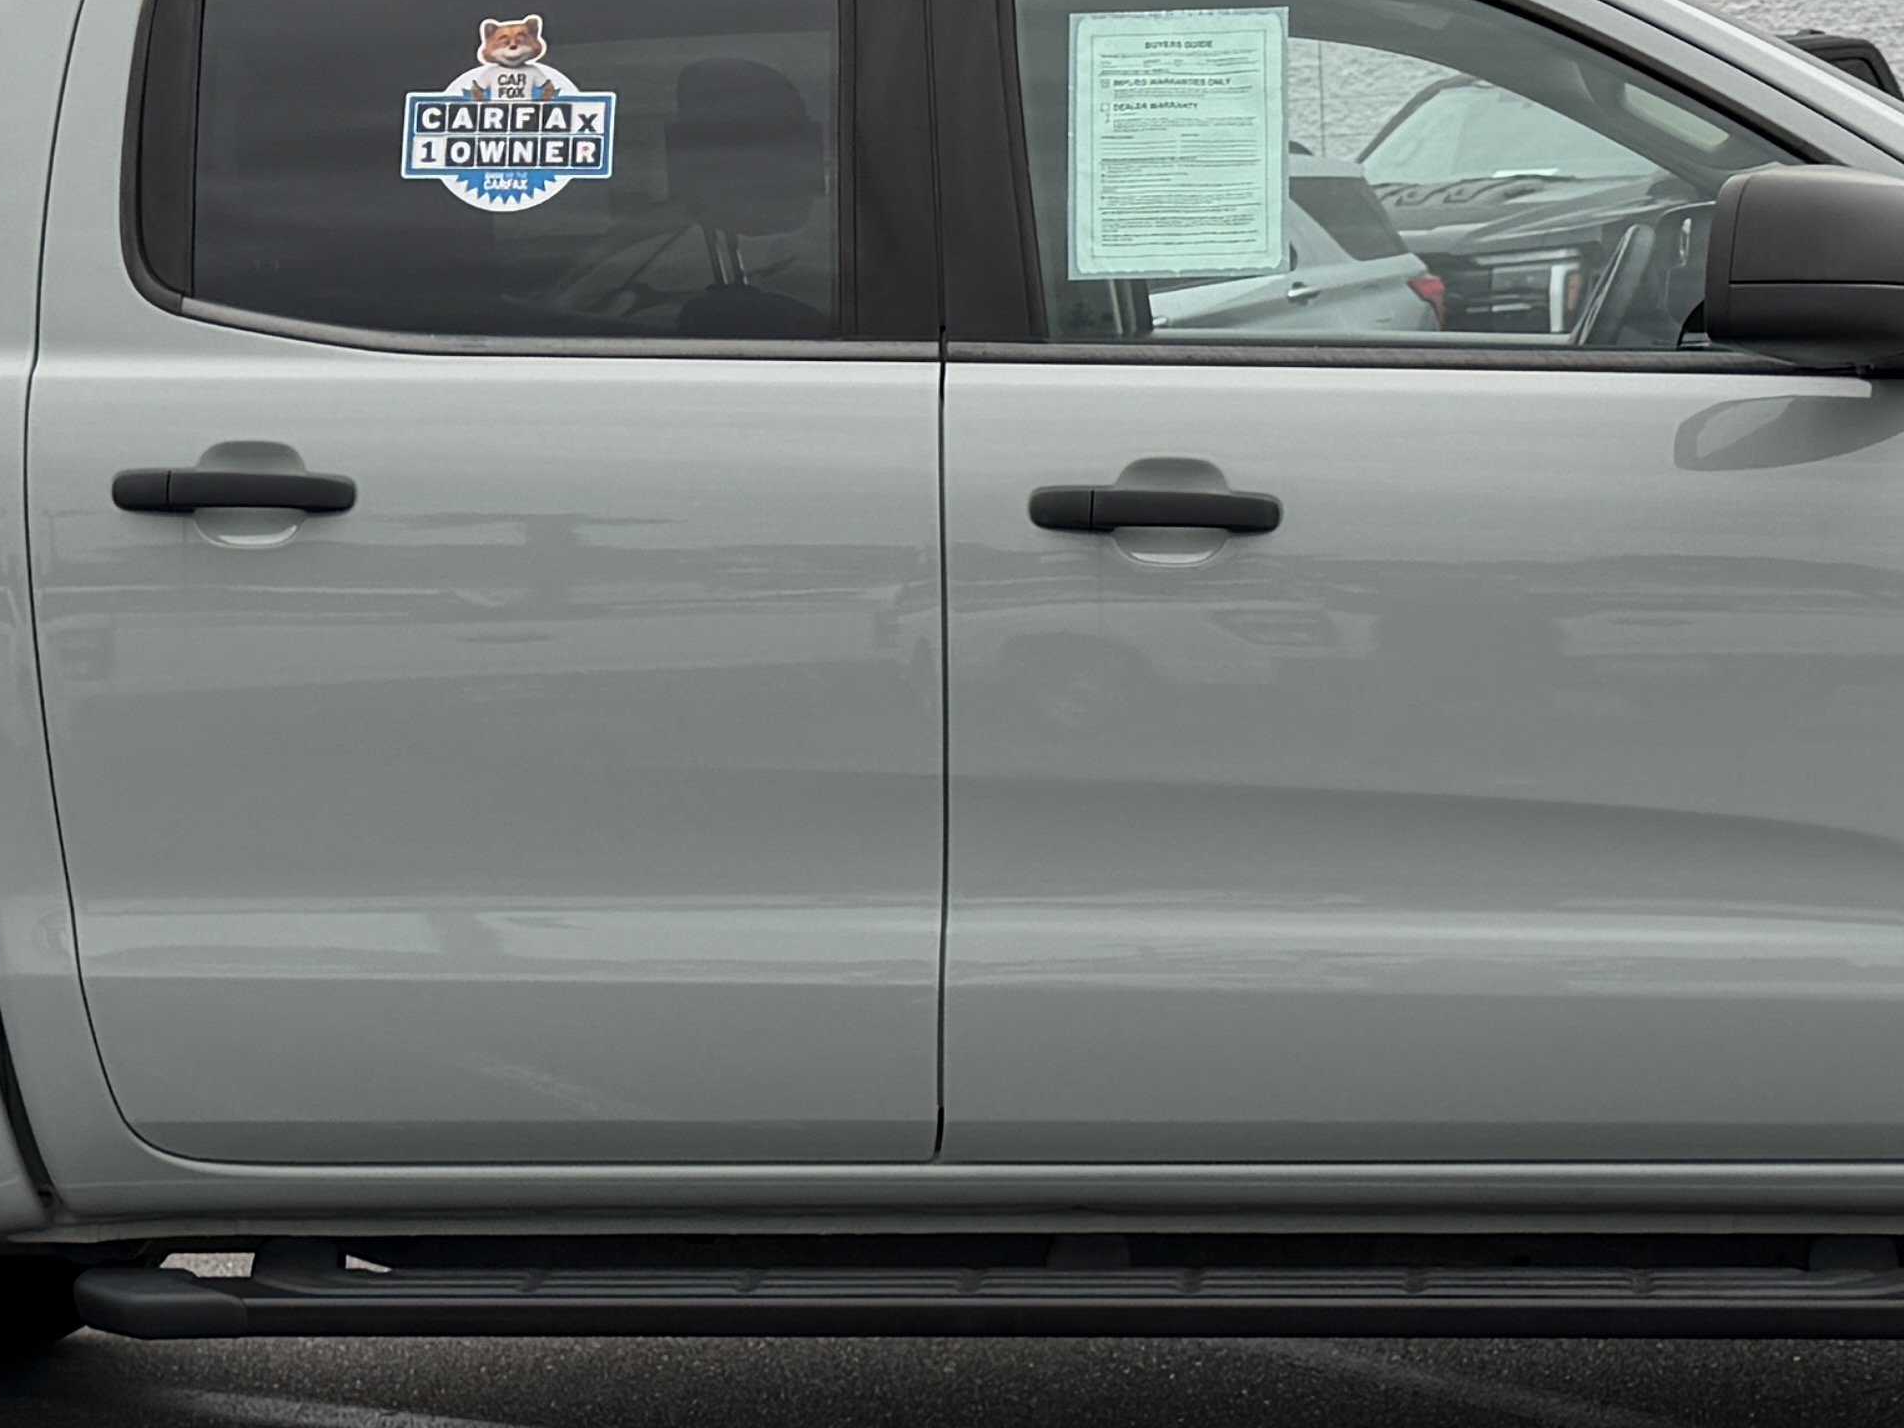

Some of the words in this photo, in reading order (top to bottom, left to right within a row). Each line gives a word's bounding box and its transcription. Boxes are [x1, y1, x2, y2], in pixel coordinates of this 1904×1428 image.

[1184, 39, 1213, 49] GUIDE
[498, 73, 527, 86] CAR
[498, 87, 525, 99] FOX
[421, 107, 598, 132] CARFAX
